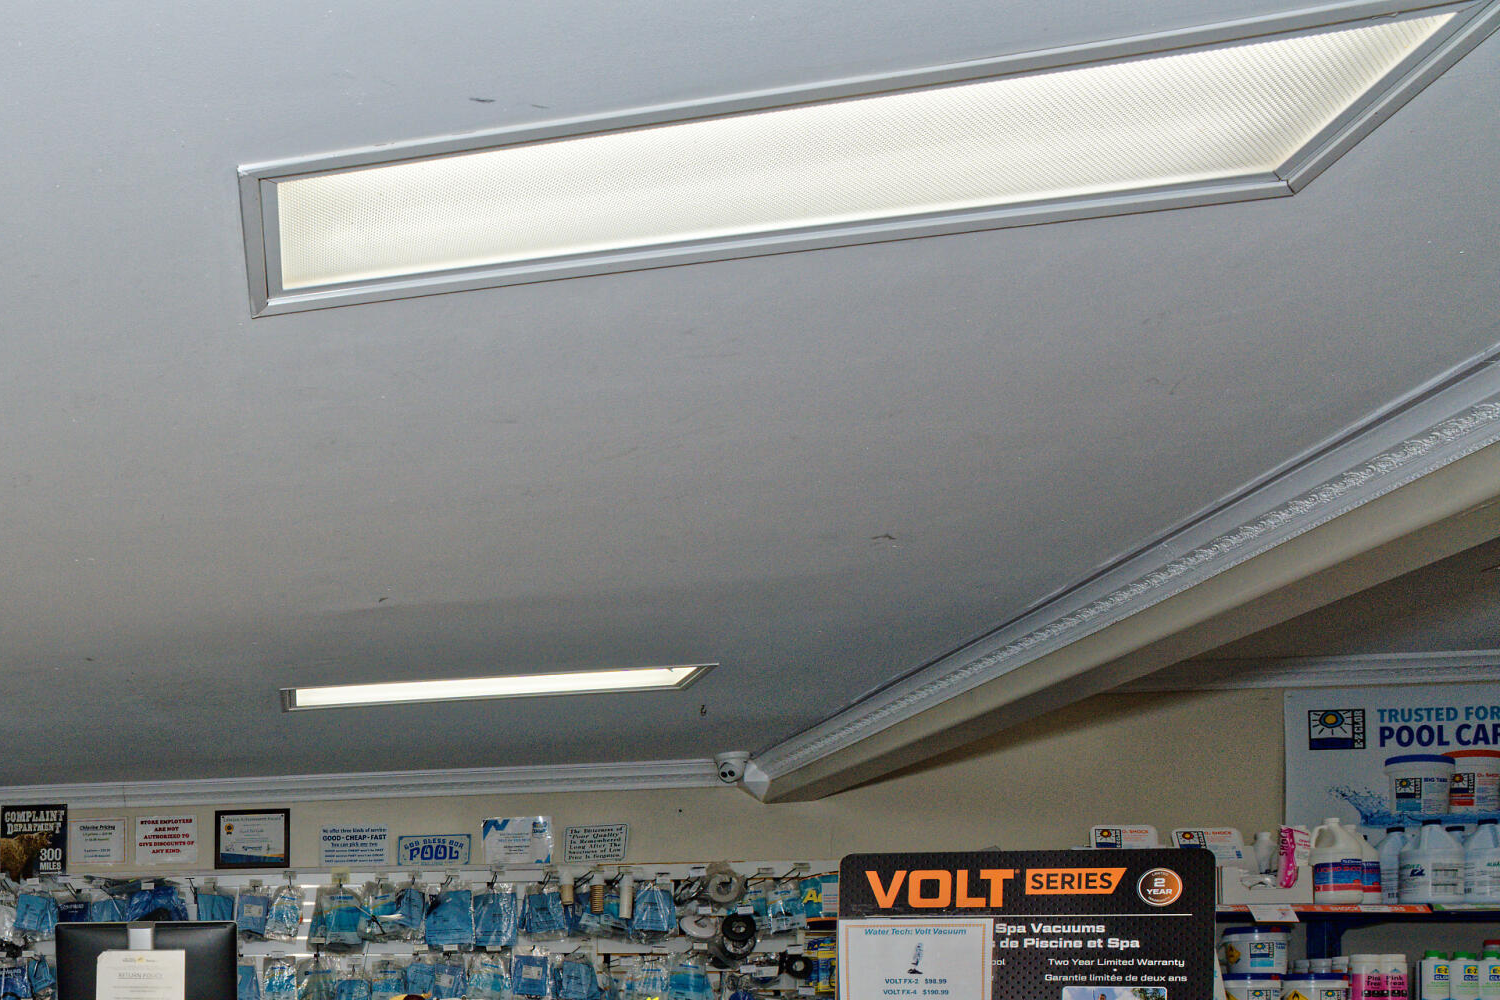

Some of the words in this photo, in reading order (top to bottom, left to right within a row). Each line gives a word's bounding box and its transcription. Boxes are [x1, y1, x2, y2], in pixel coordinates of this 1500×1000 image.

[1377, 708, 1458, 723] TRUSTED
[1465, 705, 1500, 721] FOR
[1380, 725, 1449, 747] POOL
[4, 810, 64, 823] COMPLAINT
[6, 822, 61, 834] DEPARTMENT
[39, 848, 61, 861] 300
[409, 845, 460, 861] POOL
[39, 861, 61, 871] MILES
[865, 868, 1015, 908] VOLT
[1030, 871, 1113, 891] SERIES
[1153, 878, 1165, 888] 2
[1146, 887, 1172, 895] YEAR
[864, 928, 887, 936] Water
[889, 928, 913, 936] Tech:
[915, 928, 931, 936] Volt
[933, 928, 967, 936] Vacuum
[995, 923, 1026, 936] Spa
[1030, 922, 1105, 934] Vacuums
[1000, 937, 1019, 948] de
[1023, 937, 1082, 948] Piscine
[1086, 938, 1103, 948] et
[1108, 938, 1140, 950] Spa
[1048, 958, 1067, 967] Two
[1070, 958, 1093, 967] Year
[1096, 958, 1133, 966] Limited
[1136, 958, 1185, 968] Warranty
